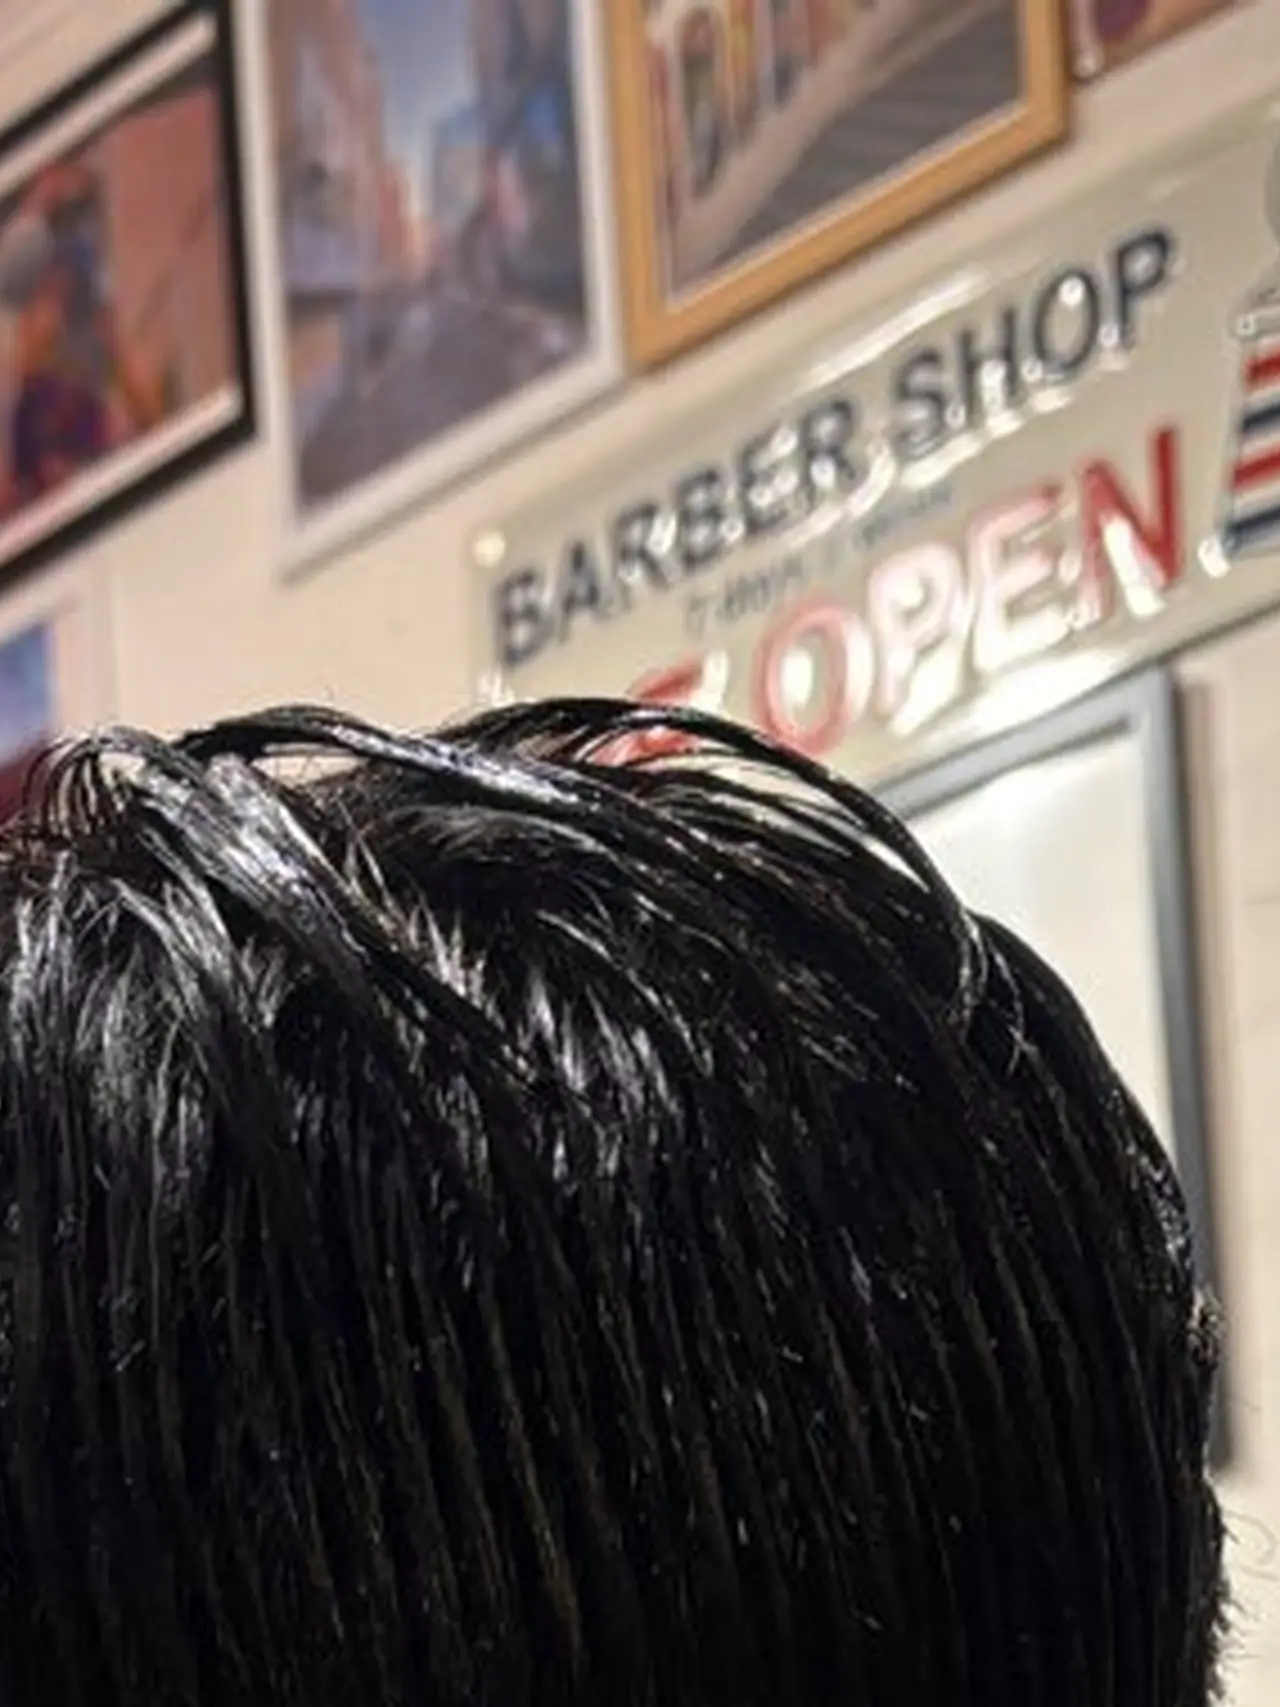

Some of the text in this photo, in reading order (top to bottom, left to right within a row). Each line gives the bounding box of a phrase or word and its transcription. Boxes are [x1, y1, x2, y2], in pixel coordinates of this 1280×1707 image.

[493, 226, 1176, 669] BARBER SHOP
[751, 423, 1182, 757] OPEN
